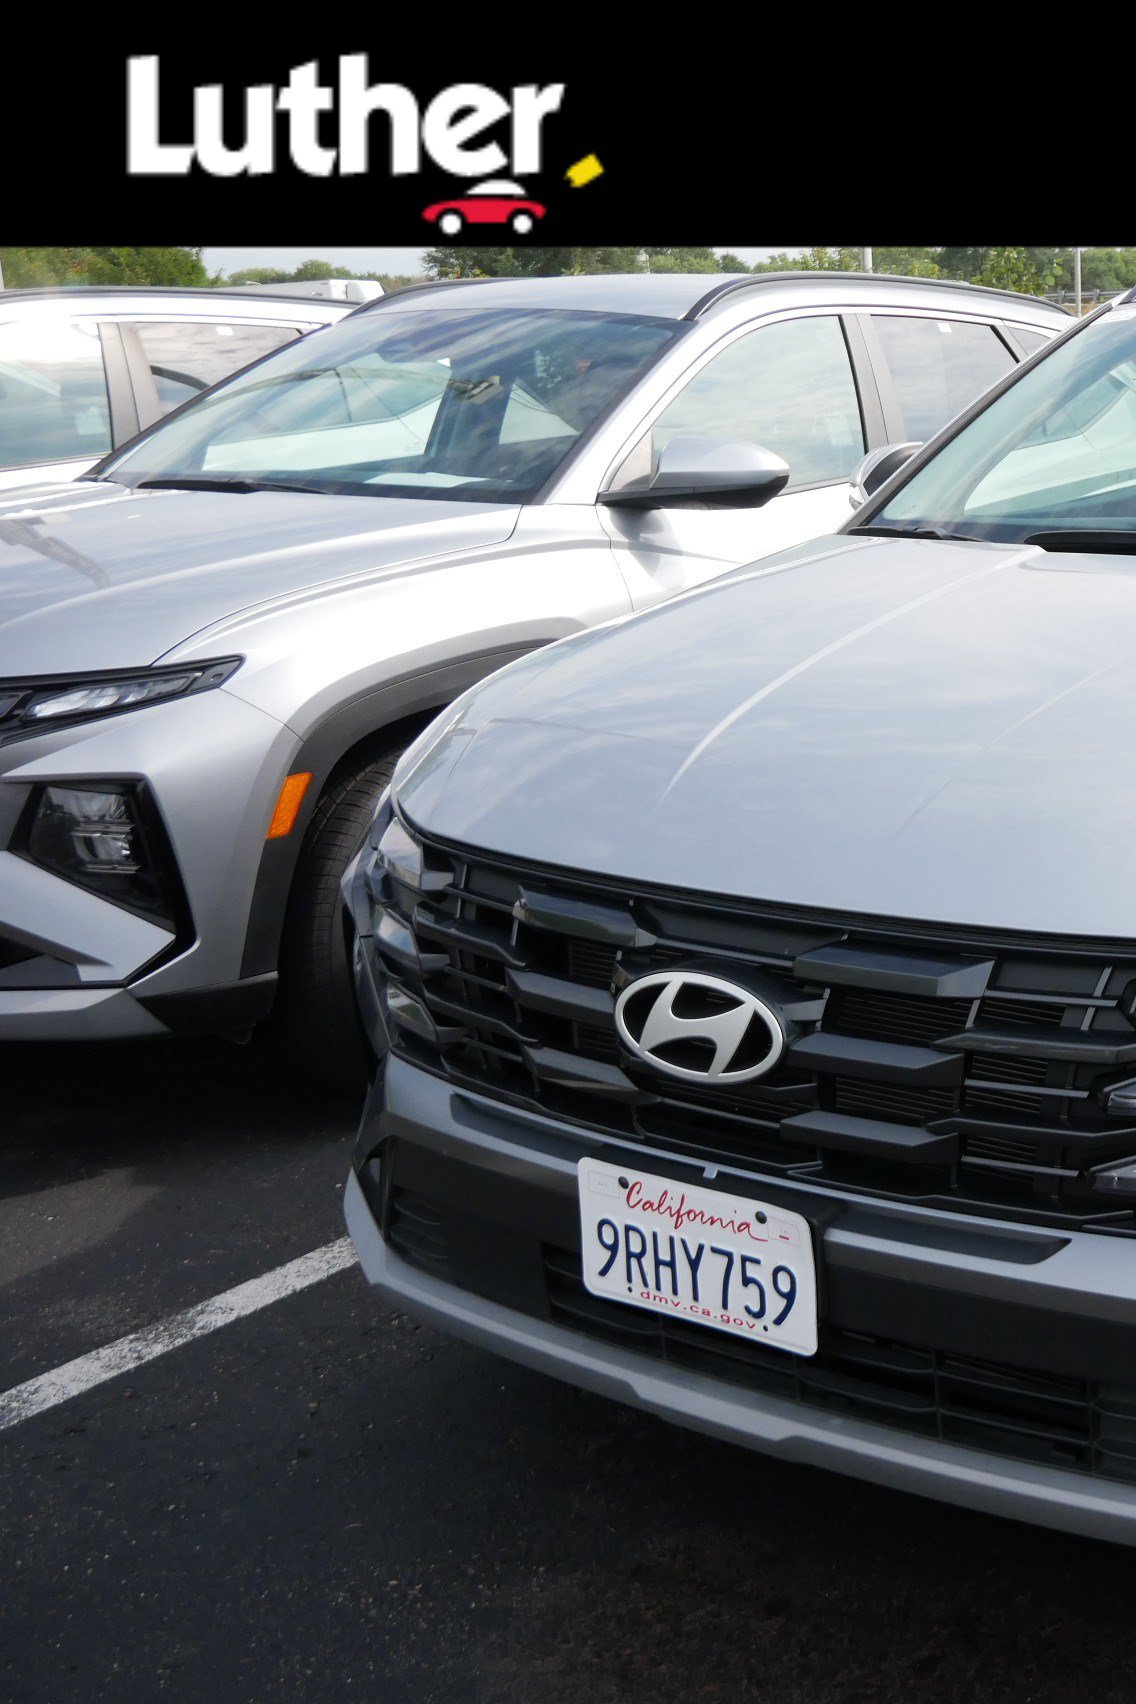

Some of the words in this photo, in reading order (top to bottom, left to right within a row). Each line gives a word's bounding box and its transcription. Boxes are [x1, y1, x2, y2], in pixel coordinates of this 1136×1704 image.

[626, 1180, 769, 1242] California
[596, 1217, 798, 1326] 9RHY759
[640, 1290, 756, 1330] dmv.ca.gov
